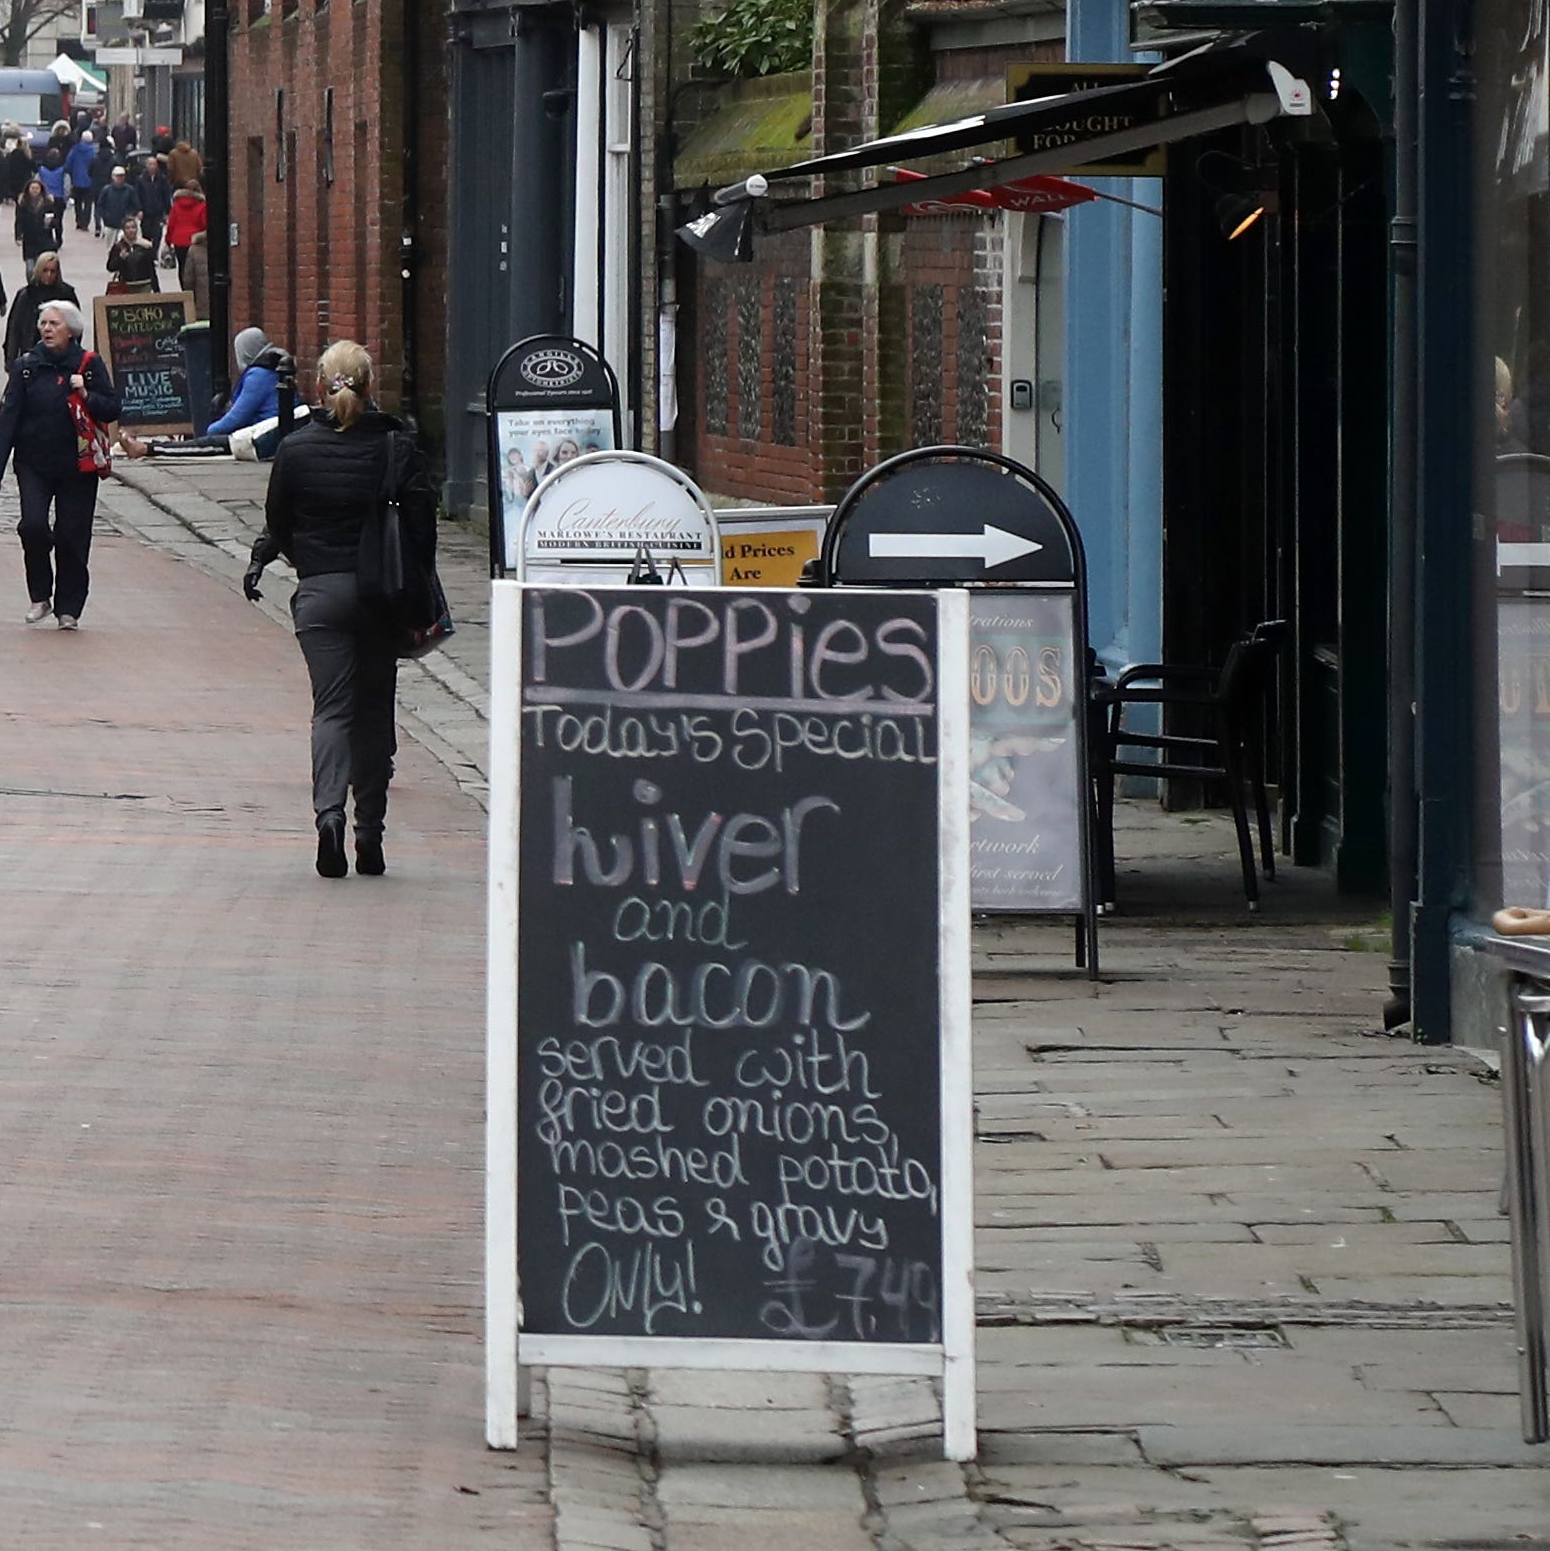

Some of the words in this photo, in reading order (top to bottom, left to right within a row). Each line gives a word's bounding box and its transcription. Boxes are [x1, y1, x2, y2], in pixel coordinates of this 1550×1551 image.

[123, 307, 163, 322] BOHO
[124, 383, 174, 398] MUSIC
[127, 371, 171, 387] LIVE
[507, 418, 531, 427] Take
[546, 418, 596, 430] everything
[537, 530, 615, 539] MARLOWE'S
[618, 531, 703, 540] RESTAURANT
[556, 497, 684, 536] Canterbury
[740, 544, 795, 559] Prices
[729, 566, 762, 581] Are
[520, 704, 724, 763] Today's
[614, 896, 749, 951] and
[572, 941, 872, 1031] bacon
[537, 1028, 711, 1088] served
[736, 1030, 883, 1100] with
[535, 1079, 674, 1146] fried
[549, 1133, 750, 1190] mashed
[557, 1182, 685, 1247] peas
[750, 1200, 890, 1273] gravy
